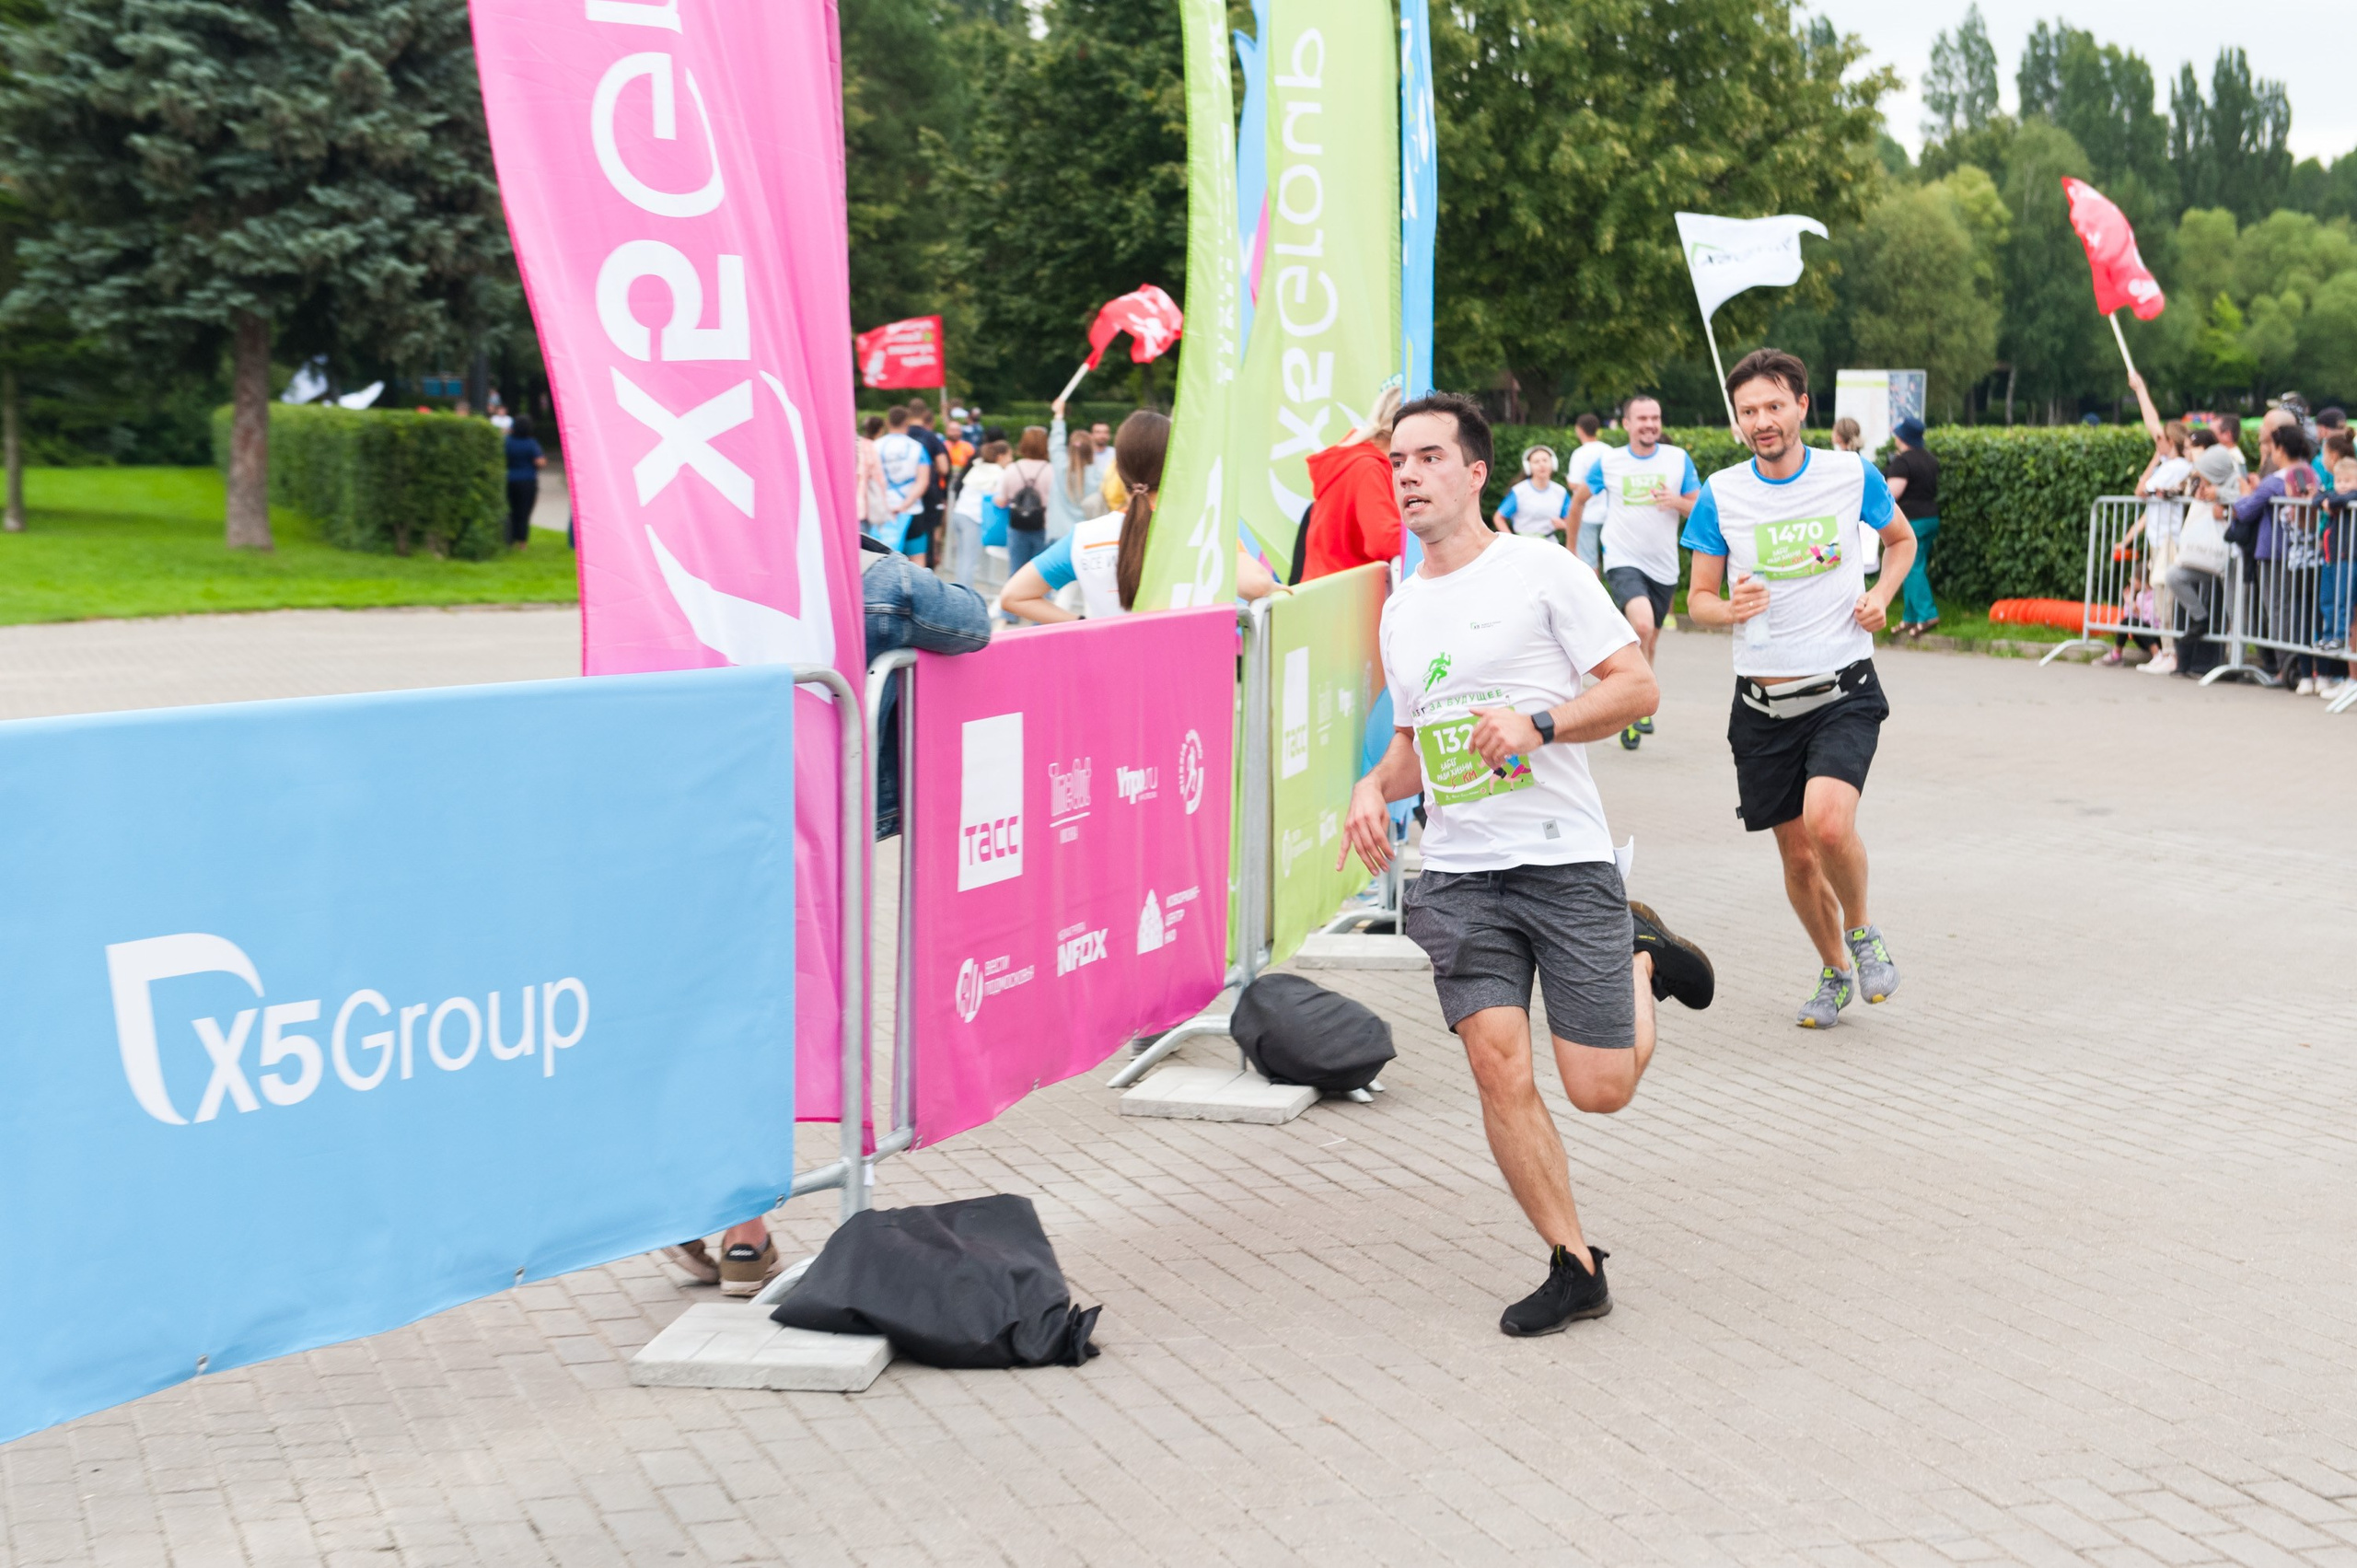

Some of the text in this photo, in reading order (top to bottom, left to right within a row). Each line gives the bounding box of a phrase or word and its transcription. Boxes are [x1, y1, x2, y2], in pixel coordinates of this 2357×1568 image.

[1767, 521, 1824, 545] 1470
[1430, 701, 1443, 712] ЗА
[1446, 689, 1503, 707] БУДУЩЕЕ
